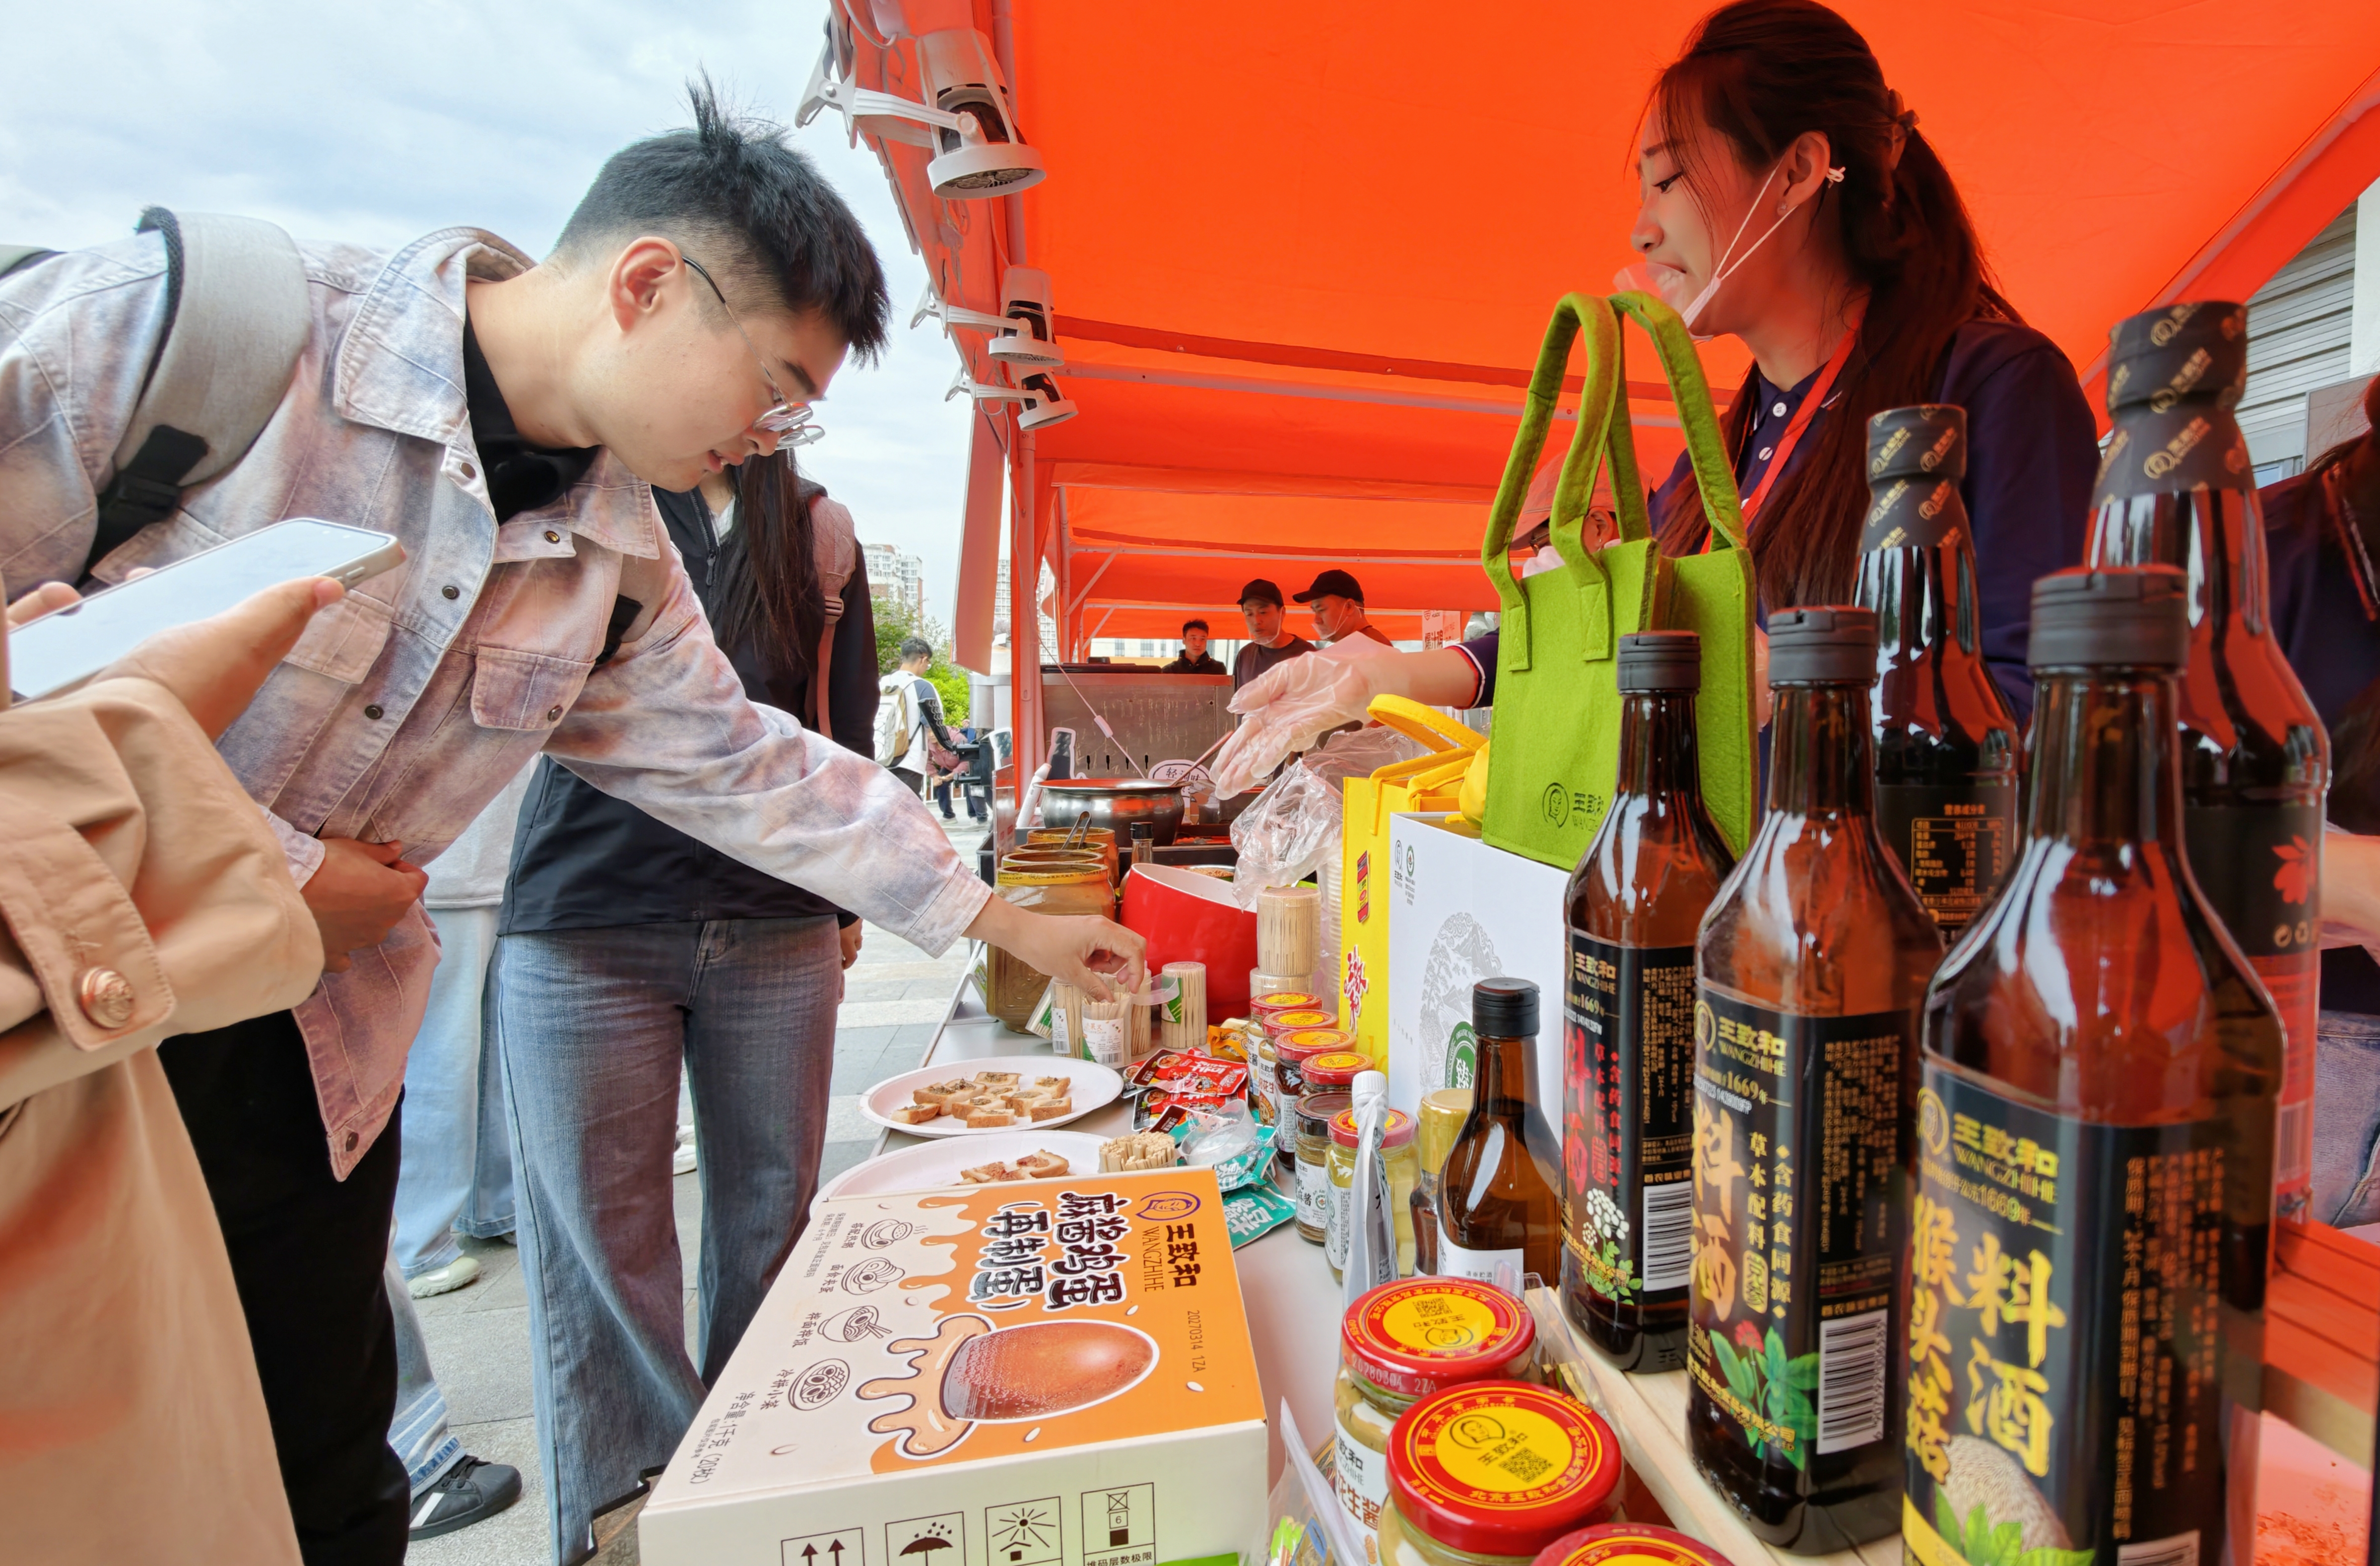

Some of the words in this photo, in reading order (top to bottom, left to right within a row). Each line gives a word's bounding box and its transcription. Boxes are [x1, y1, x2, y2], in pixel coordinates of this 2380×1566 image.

[1575, 951, 1616, 980] 王致和
[1719, 1016, 1786, 1057] 王致和
[1718, 1040, 1786, 1077] WANGZHIHE
[1953, 1111, 2059, 1178] 王致和
[1746, 1131, 1768, 1250] 草本配料
[1953, 1143, 2058, 1204] WANGZHIHE
[1047, 1192, 1129, 1310] 麻酱鸡蛋
[1771, 1162, 1794, 1303] 含药食同源
[1141, 1225, 1165, 1293] WANGZHIHE
[1166, 1223, 1201, 1289] 王致和
[818, 1264, 844, 1294] 面食夹蛋
[792, 1312, 822, 1348] 拌面拌饭
[1187, 1309, 1203, 1351] 20270314
[1413, 1313, 1466, 1328] 王致和
[1967, 1232, 2067, 1478] 料酒
[760, 1369, 795, 1410] 冷拼小菜
[1562, 1395, 1593, 1415] OPEN
[1477, 1432, 1529, 1467] 王致和
[1115, 1515, 1122, 1524] 6
